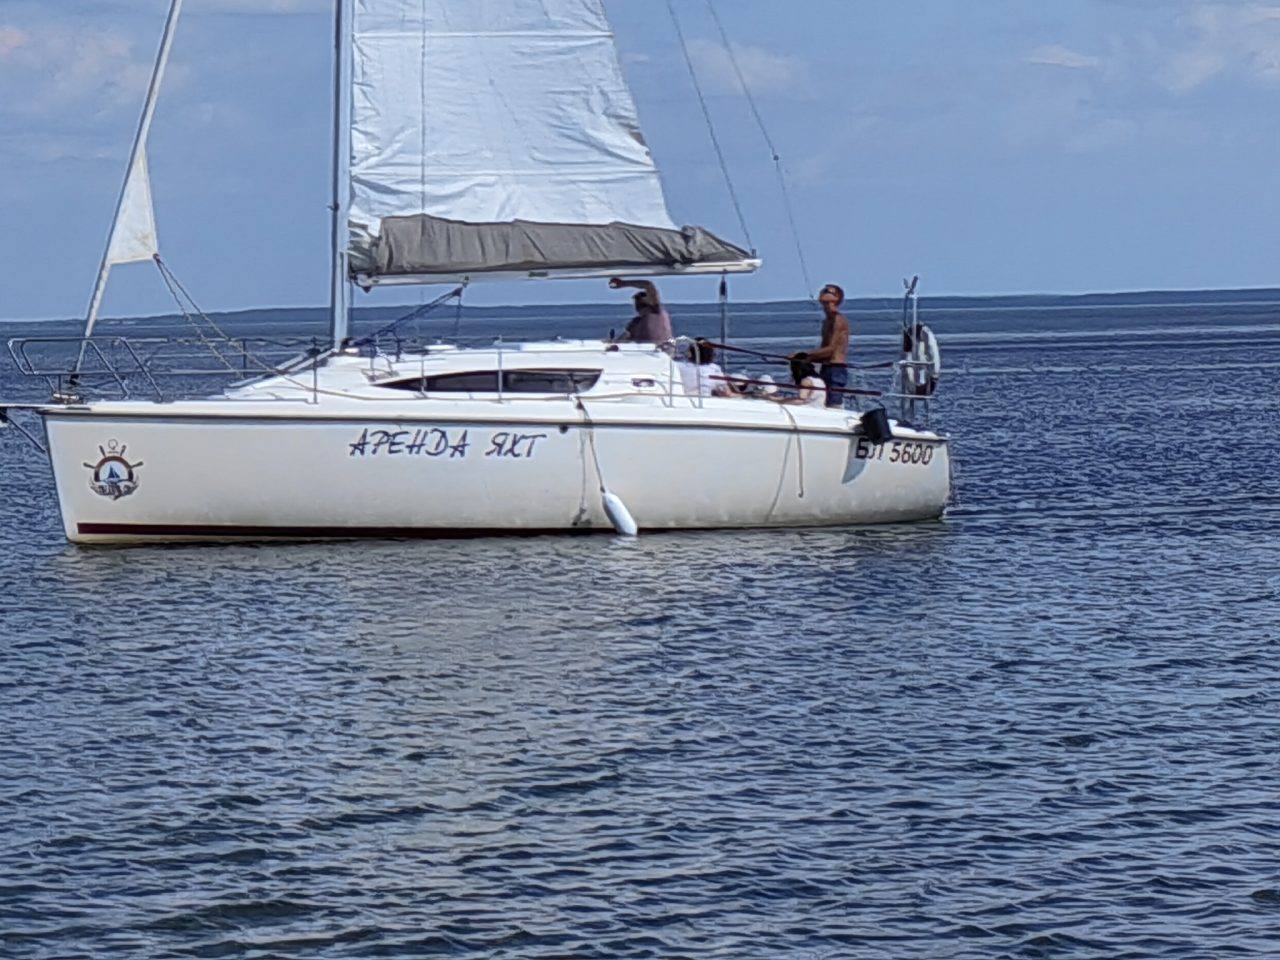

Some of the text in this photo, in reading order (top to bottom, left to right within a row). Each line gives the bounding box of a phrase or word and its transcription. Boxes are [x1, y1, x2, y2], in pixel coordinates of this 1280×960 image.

[349, 428, 548, 458] АРЕНДА ЯХТ
[889, 441, 934, 465] 5600
